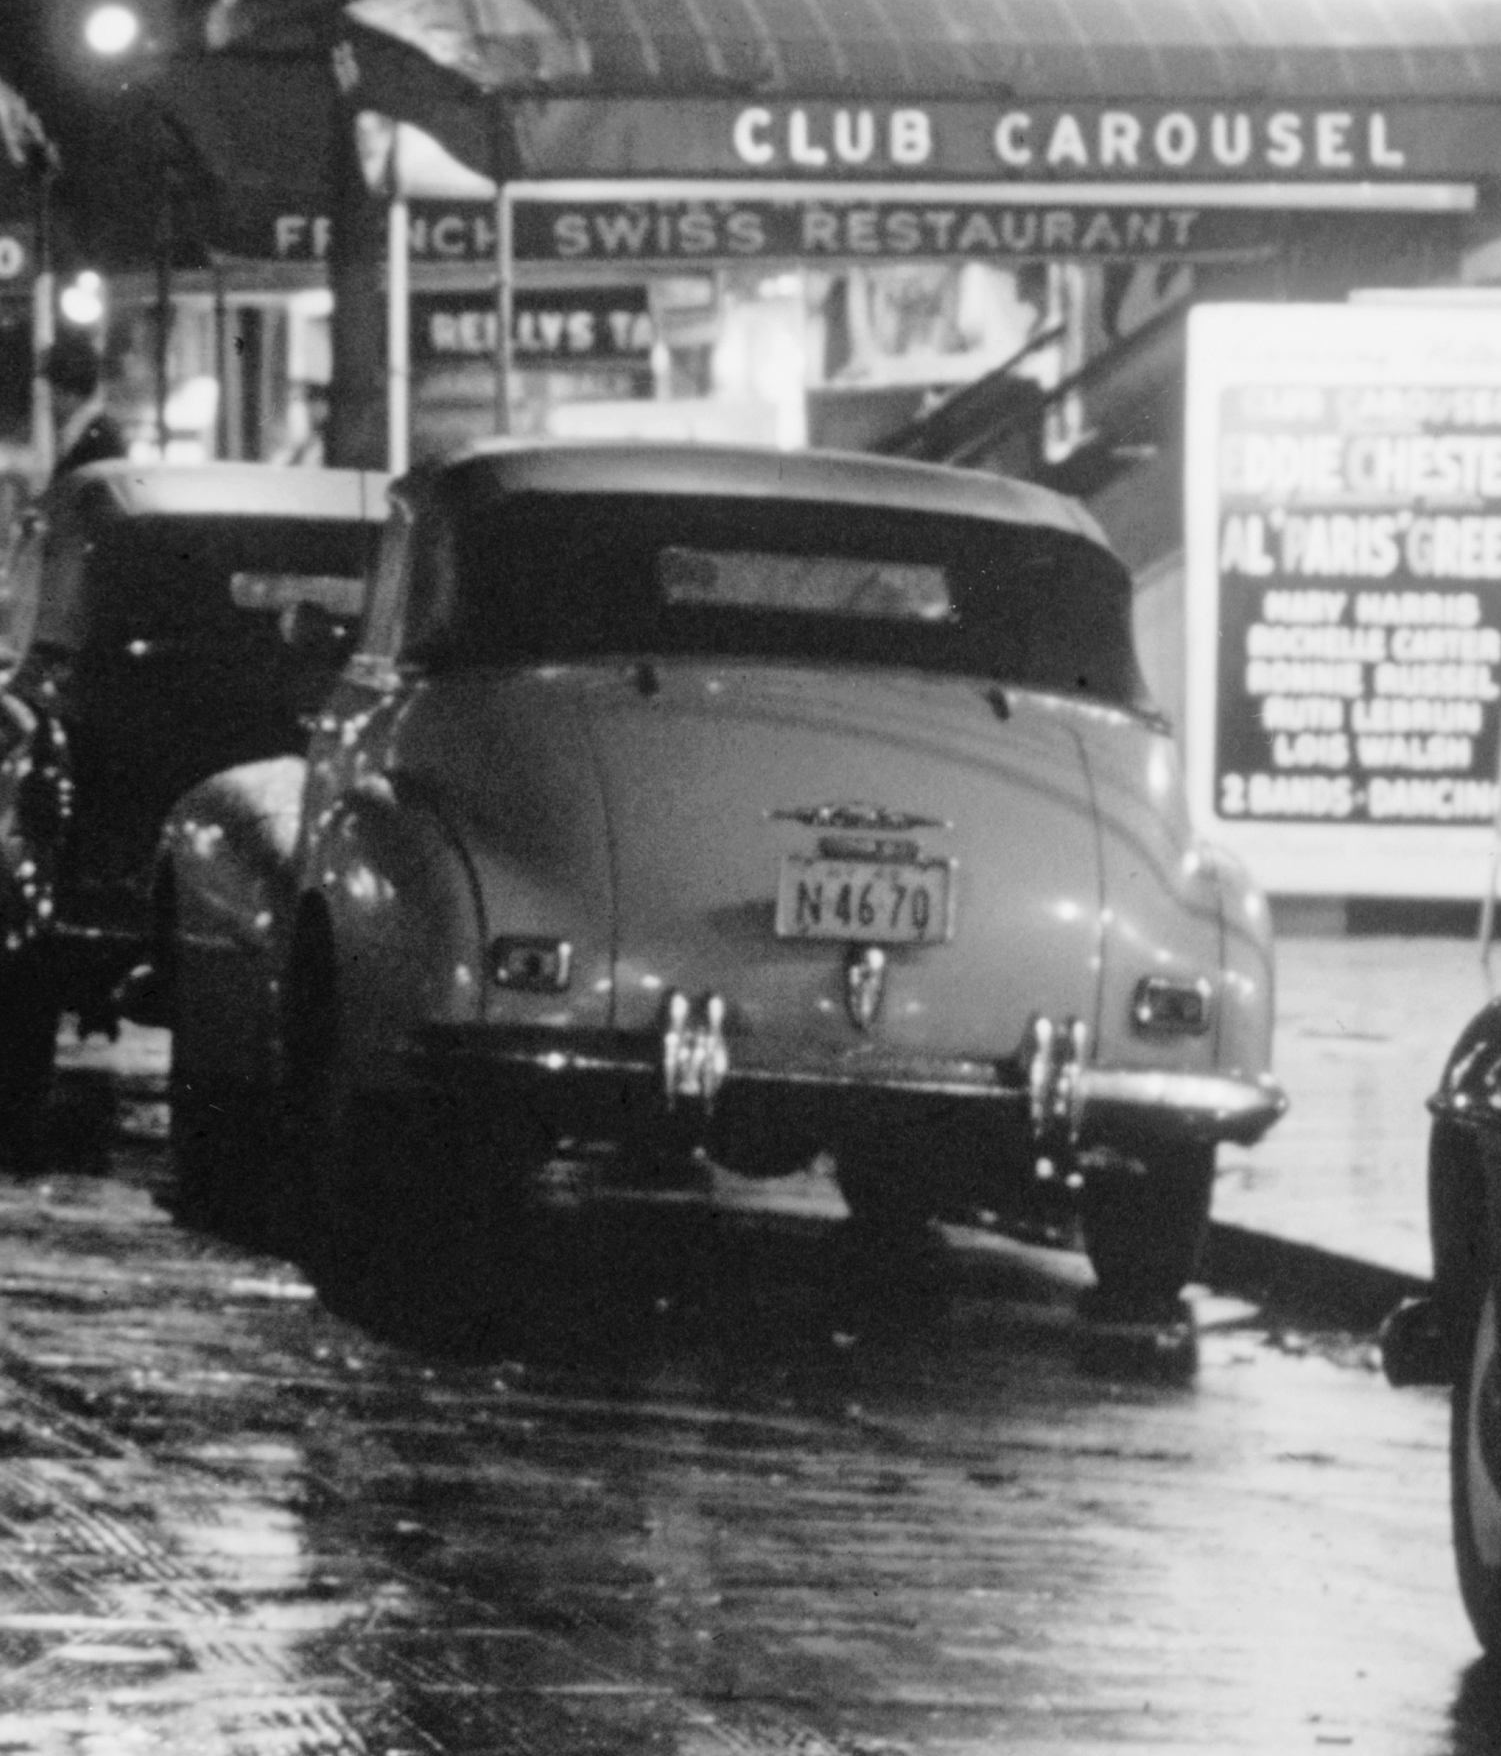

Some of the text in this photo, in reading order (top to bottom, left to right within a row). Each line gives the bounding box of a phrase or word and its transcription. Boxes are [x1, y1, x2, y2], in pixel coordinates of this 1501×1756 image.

[732, 106, 1407, 170] CLUB CAROUSEL
[553, 211, 768, 257] SWISS
[803, 208, 1199, 251] RESTAURANT
[1220, 514, 1275, 576] AL
